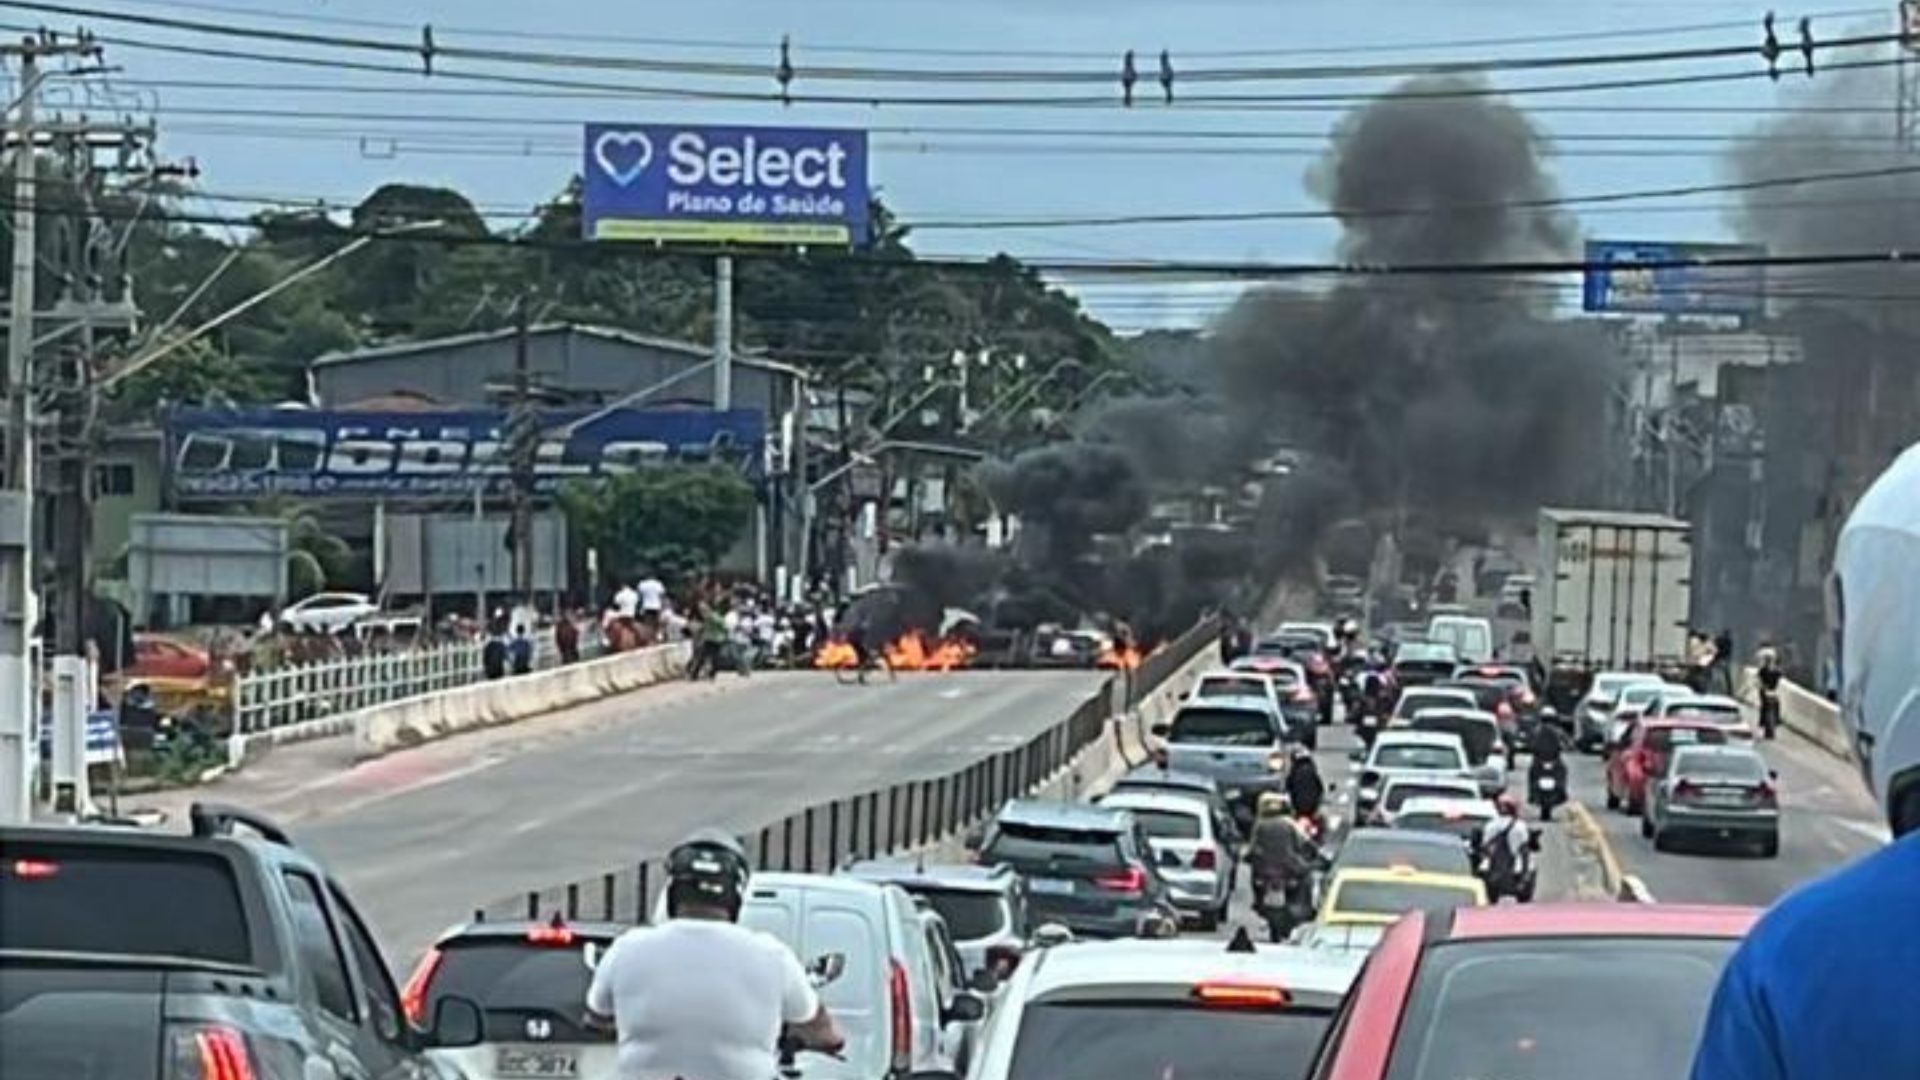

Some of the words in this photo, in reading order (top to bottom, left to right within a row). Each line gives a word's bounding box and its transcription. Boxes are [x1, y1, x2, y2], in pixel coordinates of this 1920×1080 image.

[667, 132, 846, 188] Select
[667, 191, 731, 213] Plano
[738, 192, 766, 214] de
[773, 192, 844, 215] Saúde
